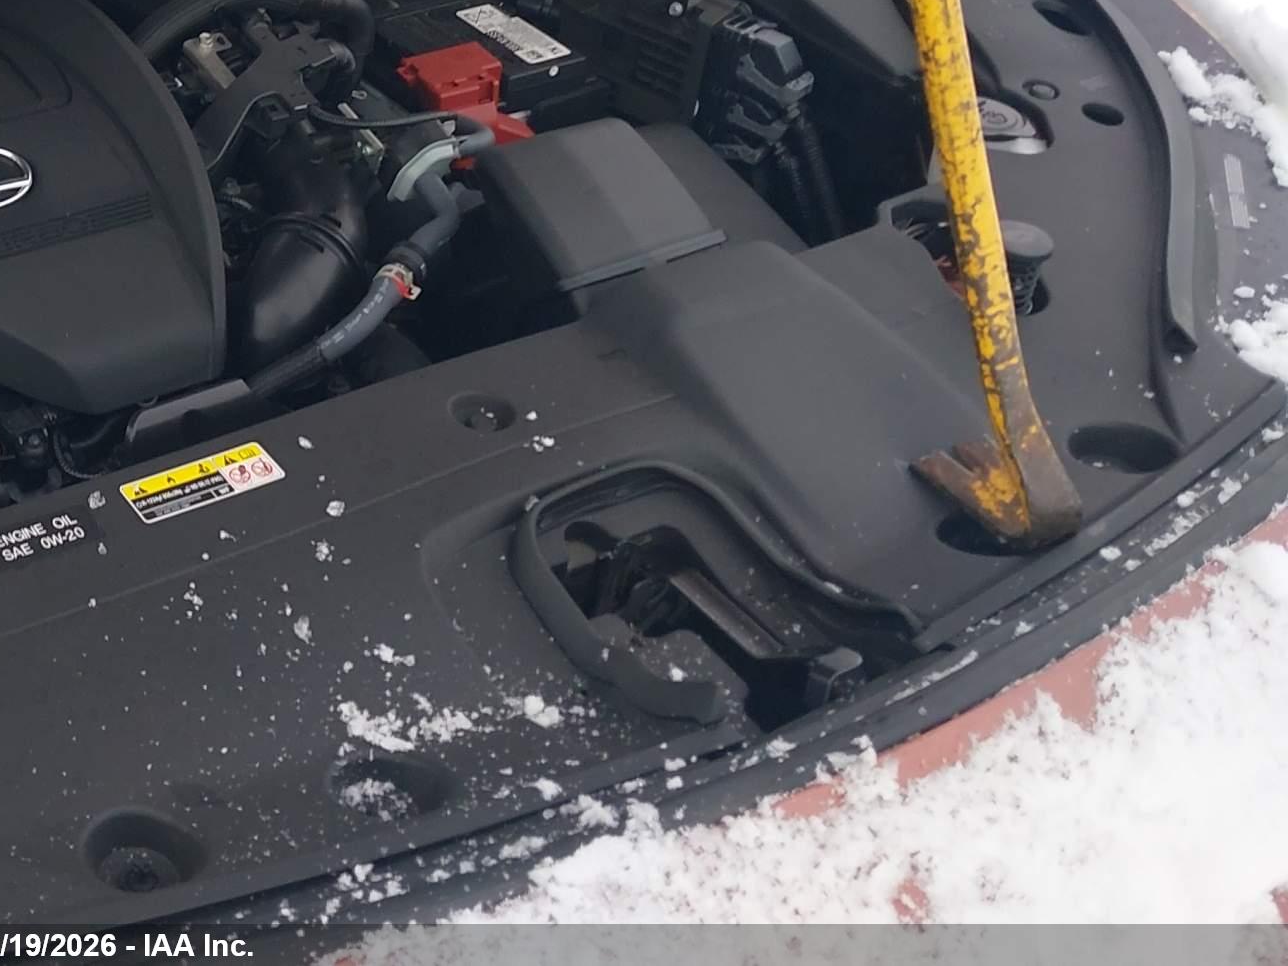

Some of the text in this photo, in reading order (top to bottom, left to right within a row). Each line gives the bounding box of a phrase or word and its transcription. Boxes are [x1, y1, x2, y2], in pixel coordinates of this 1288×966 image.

[51, 514, 79, 530] OIL
[1, 527, 86, 562] SAE 0W-20
